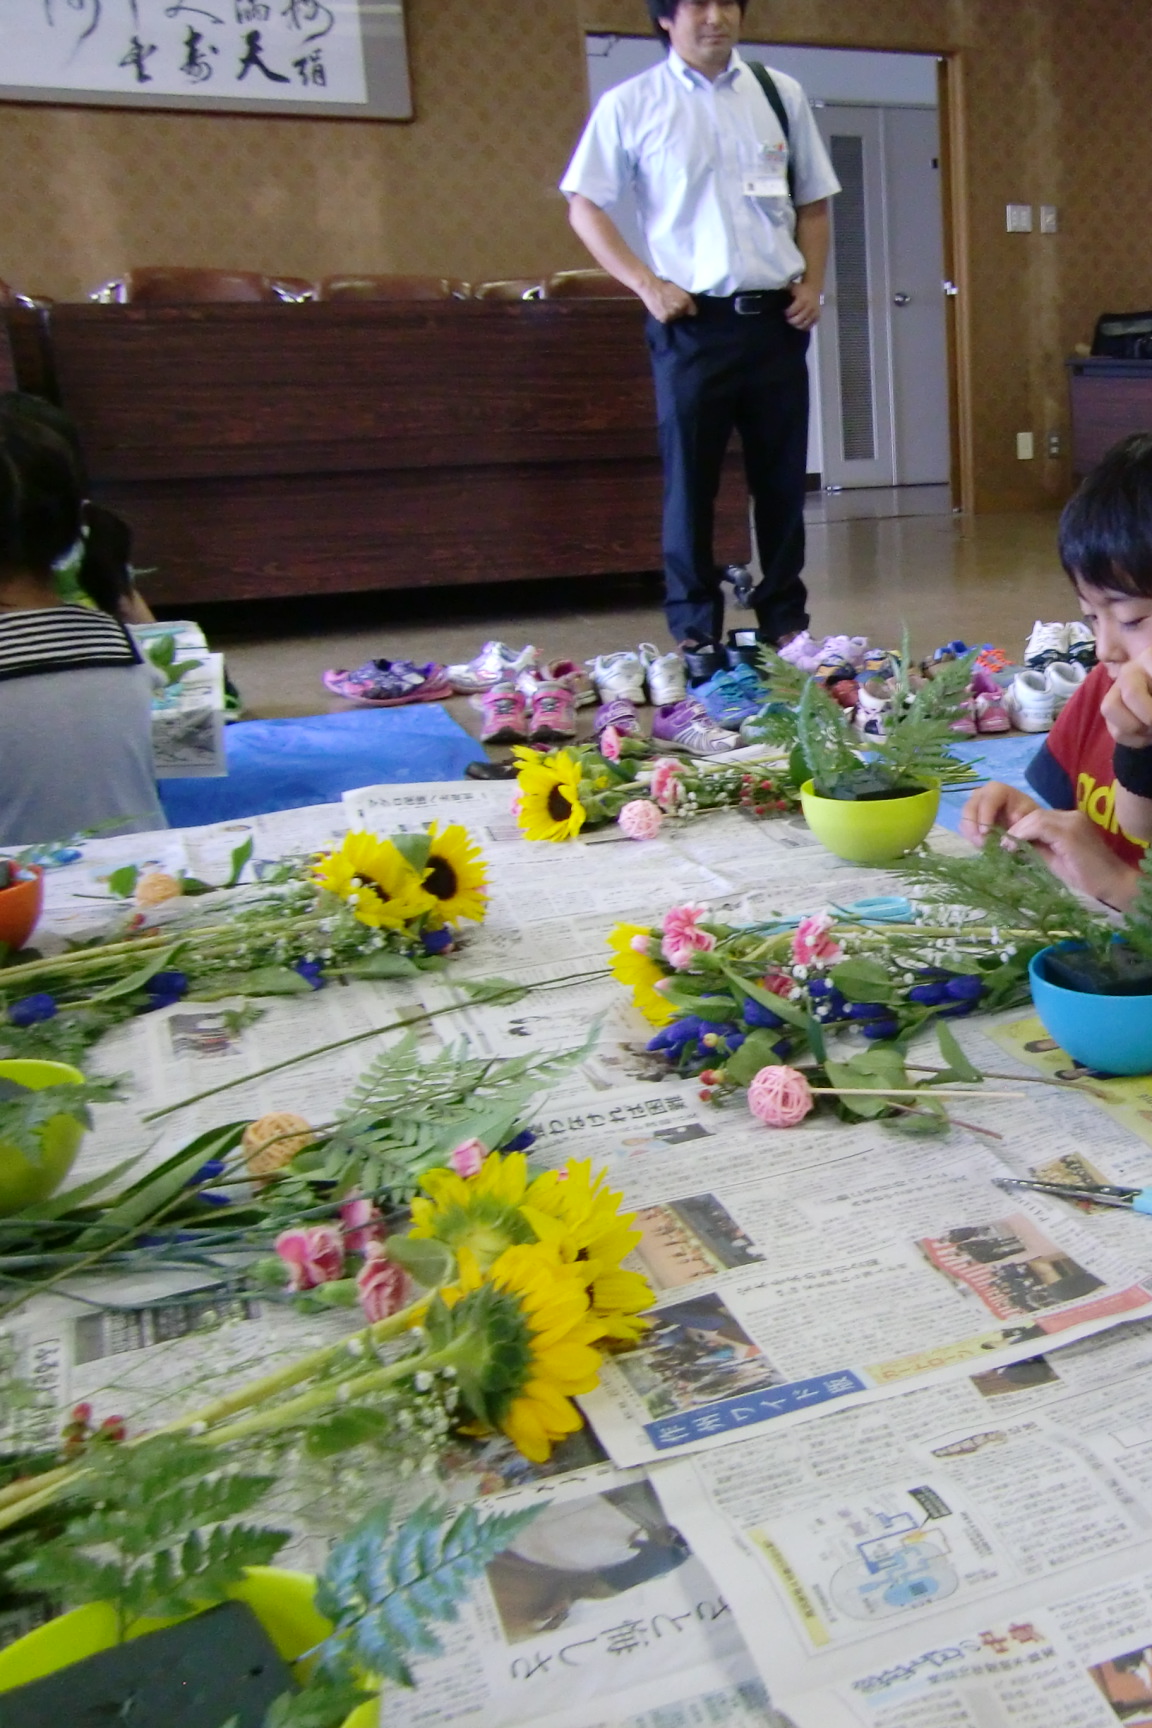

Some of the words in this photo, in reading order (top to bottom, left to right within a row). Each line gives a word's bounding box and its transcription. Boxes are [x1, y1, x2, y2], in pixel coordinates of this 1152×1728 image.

[658, 1375, 857, 1443] 作州ワイド版
